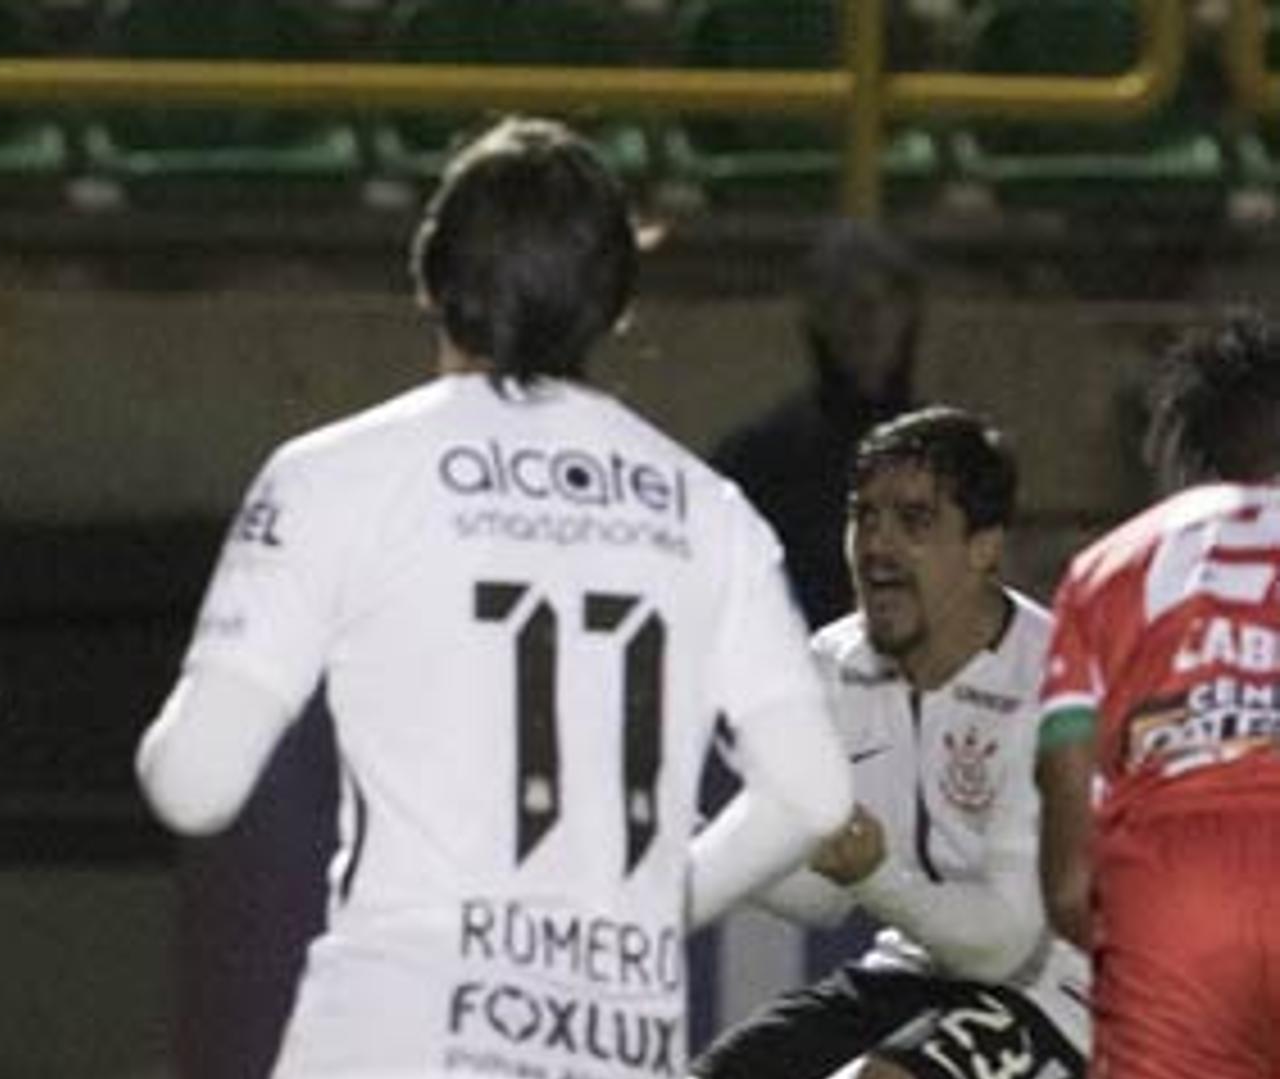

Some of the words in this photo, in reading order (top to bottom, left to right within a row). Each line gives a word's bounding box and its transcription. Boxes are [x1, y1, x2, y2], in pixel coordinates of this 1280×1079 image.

[438, 438, 688, 525] alcatel
[473, 580, 667, 880] 11
[460, 898, 681, 993] ROMERO
[448, 981, 681, 1079] FOXLUX
